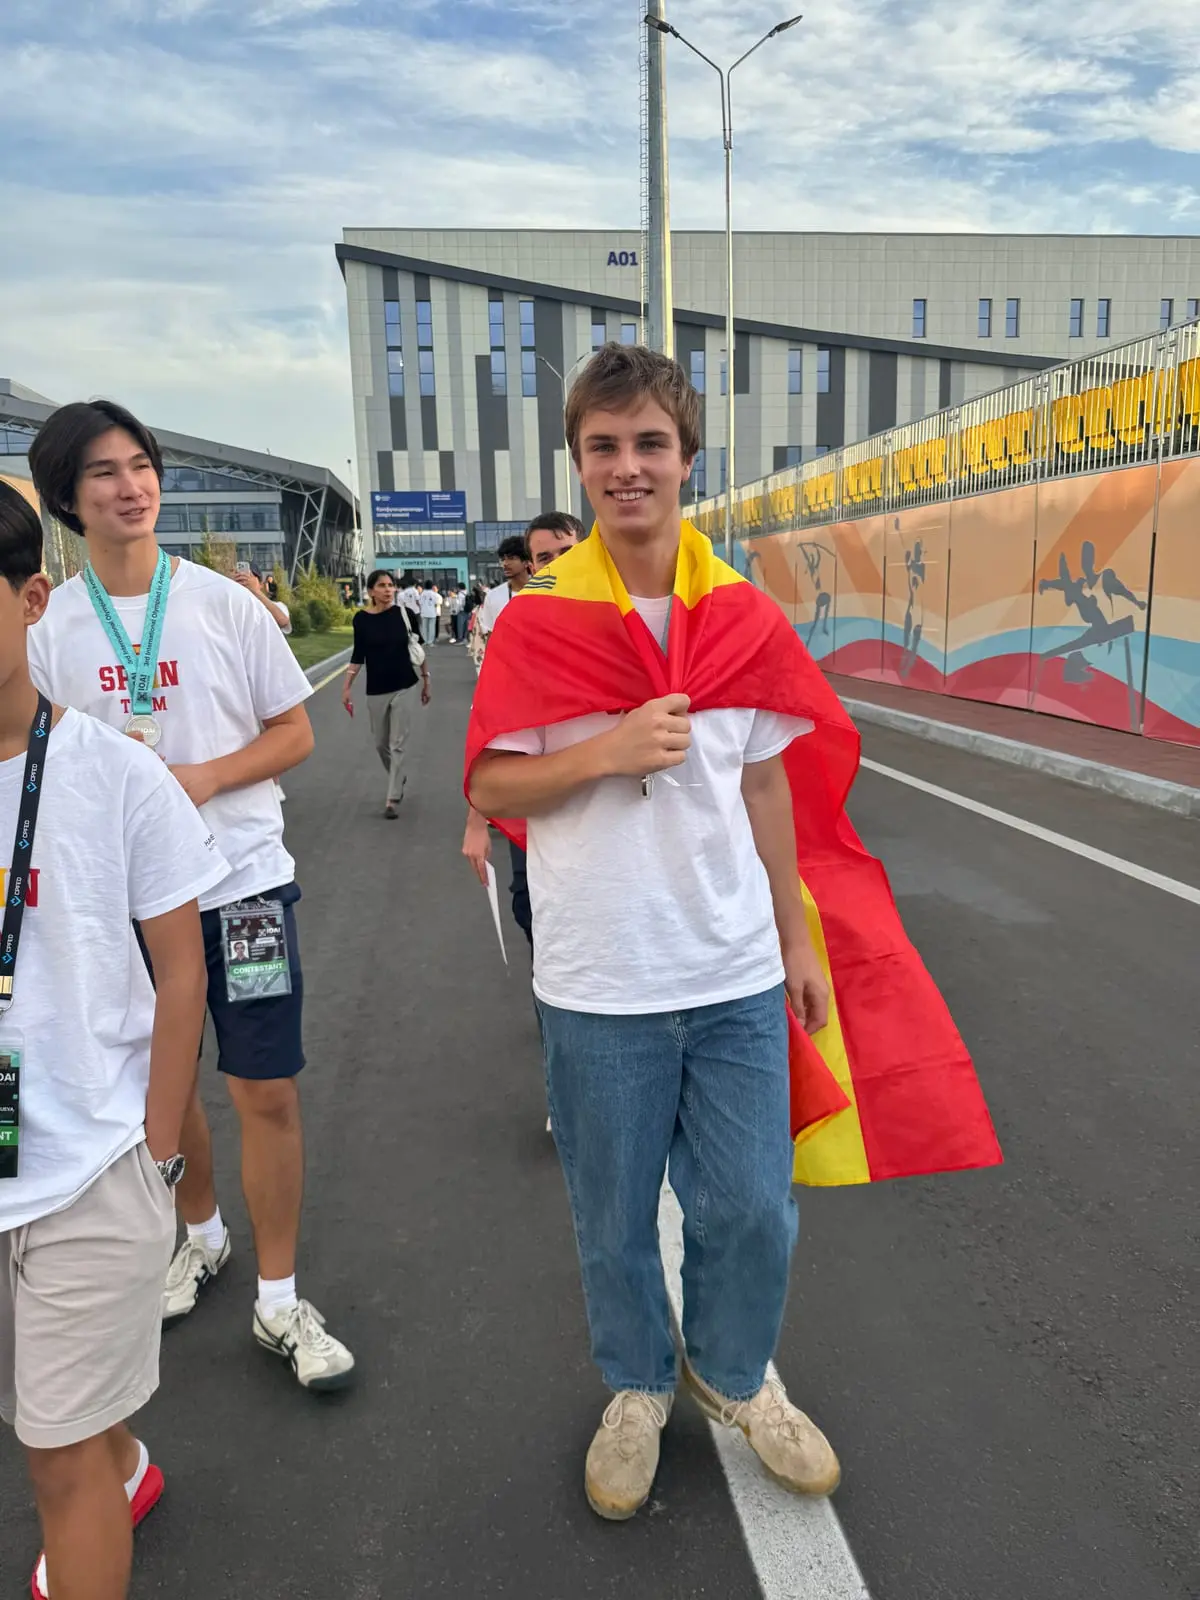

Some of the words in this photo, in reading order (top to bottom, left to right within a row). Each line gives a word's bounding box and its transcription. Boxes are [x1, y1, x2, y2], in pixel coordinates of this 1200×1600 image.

[607, 251, 639, 266] A01
[145, 619, 156, 656] International
[152, 592, 162, 619] Olympiad
[99, 661, 178, 691] SPN
[120, 696, 167, 713] TM
[30, 763, 38, 782] CPFED
[22, 819, 30, 838] CPFED
[14, 876, 22, 896] CPFED
[5, 933, 14, 953] CPFED
[233, 962, 283, 974] CONTESTANT
